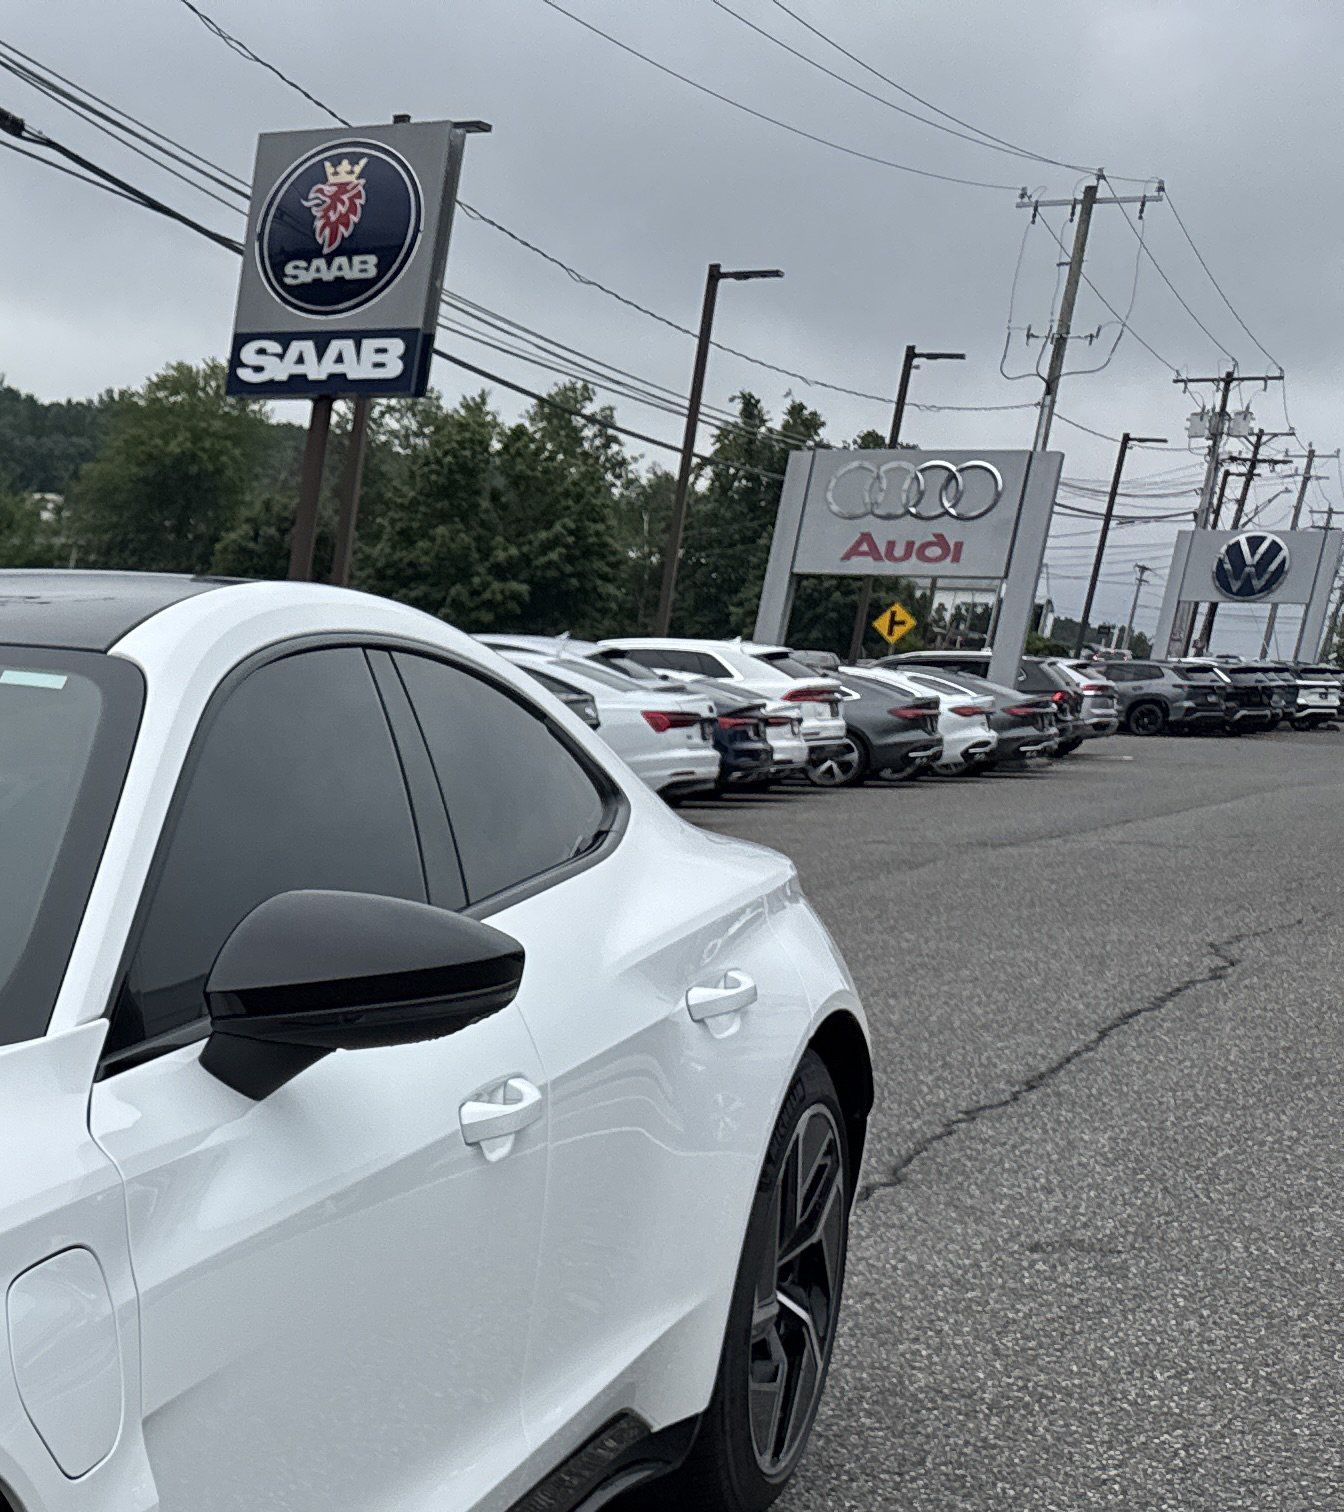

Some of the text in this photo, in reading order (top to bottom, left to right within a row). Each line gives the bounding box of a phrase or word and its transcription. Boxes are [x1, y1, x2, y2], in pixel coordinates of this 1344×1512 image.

[283, 254, 378, 285] SAAB
[236, 337, 405, 383] SAAB
[840, 531, 963, 563] Audi
